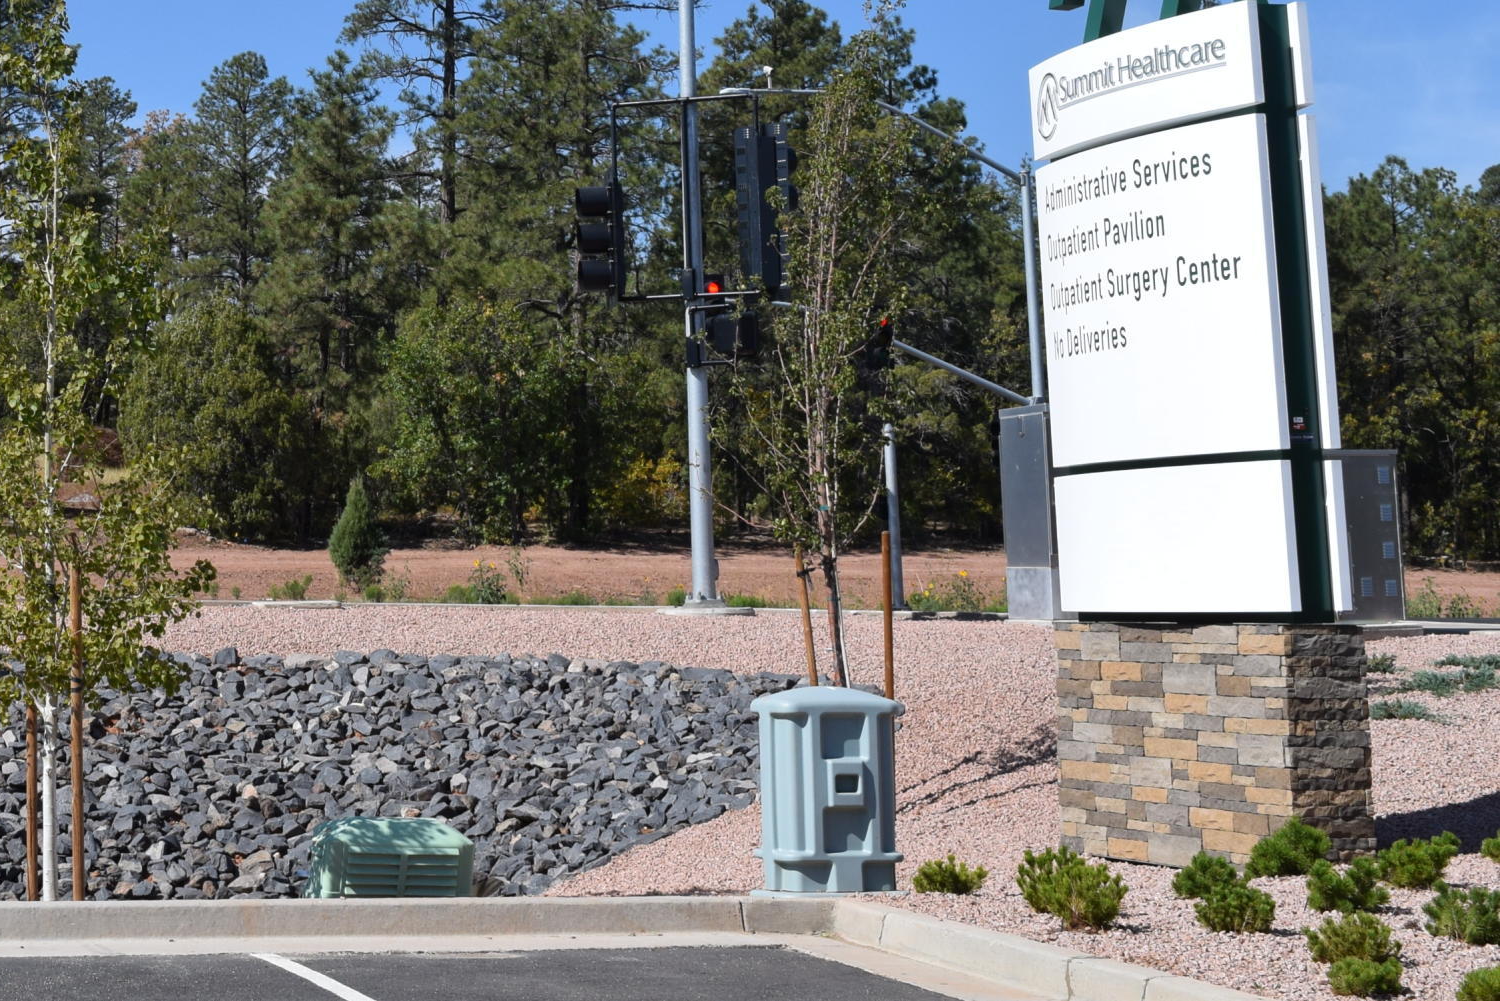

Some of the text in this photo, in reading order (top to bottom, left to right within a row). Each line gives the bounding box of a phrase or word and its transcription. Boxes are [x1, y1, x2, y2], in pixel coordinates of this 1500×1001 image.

[1060, 38, 1226, 102] Summit Healthcare
[1045, 151, 1212, 214] Administrative Services
[1047, 210, 1165, 266] Outpatient Pavilion
[1050, 253, 1242, 315] Outpatient Surgery Center
[1053, 321, 1127, 360] No Deliveries
